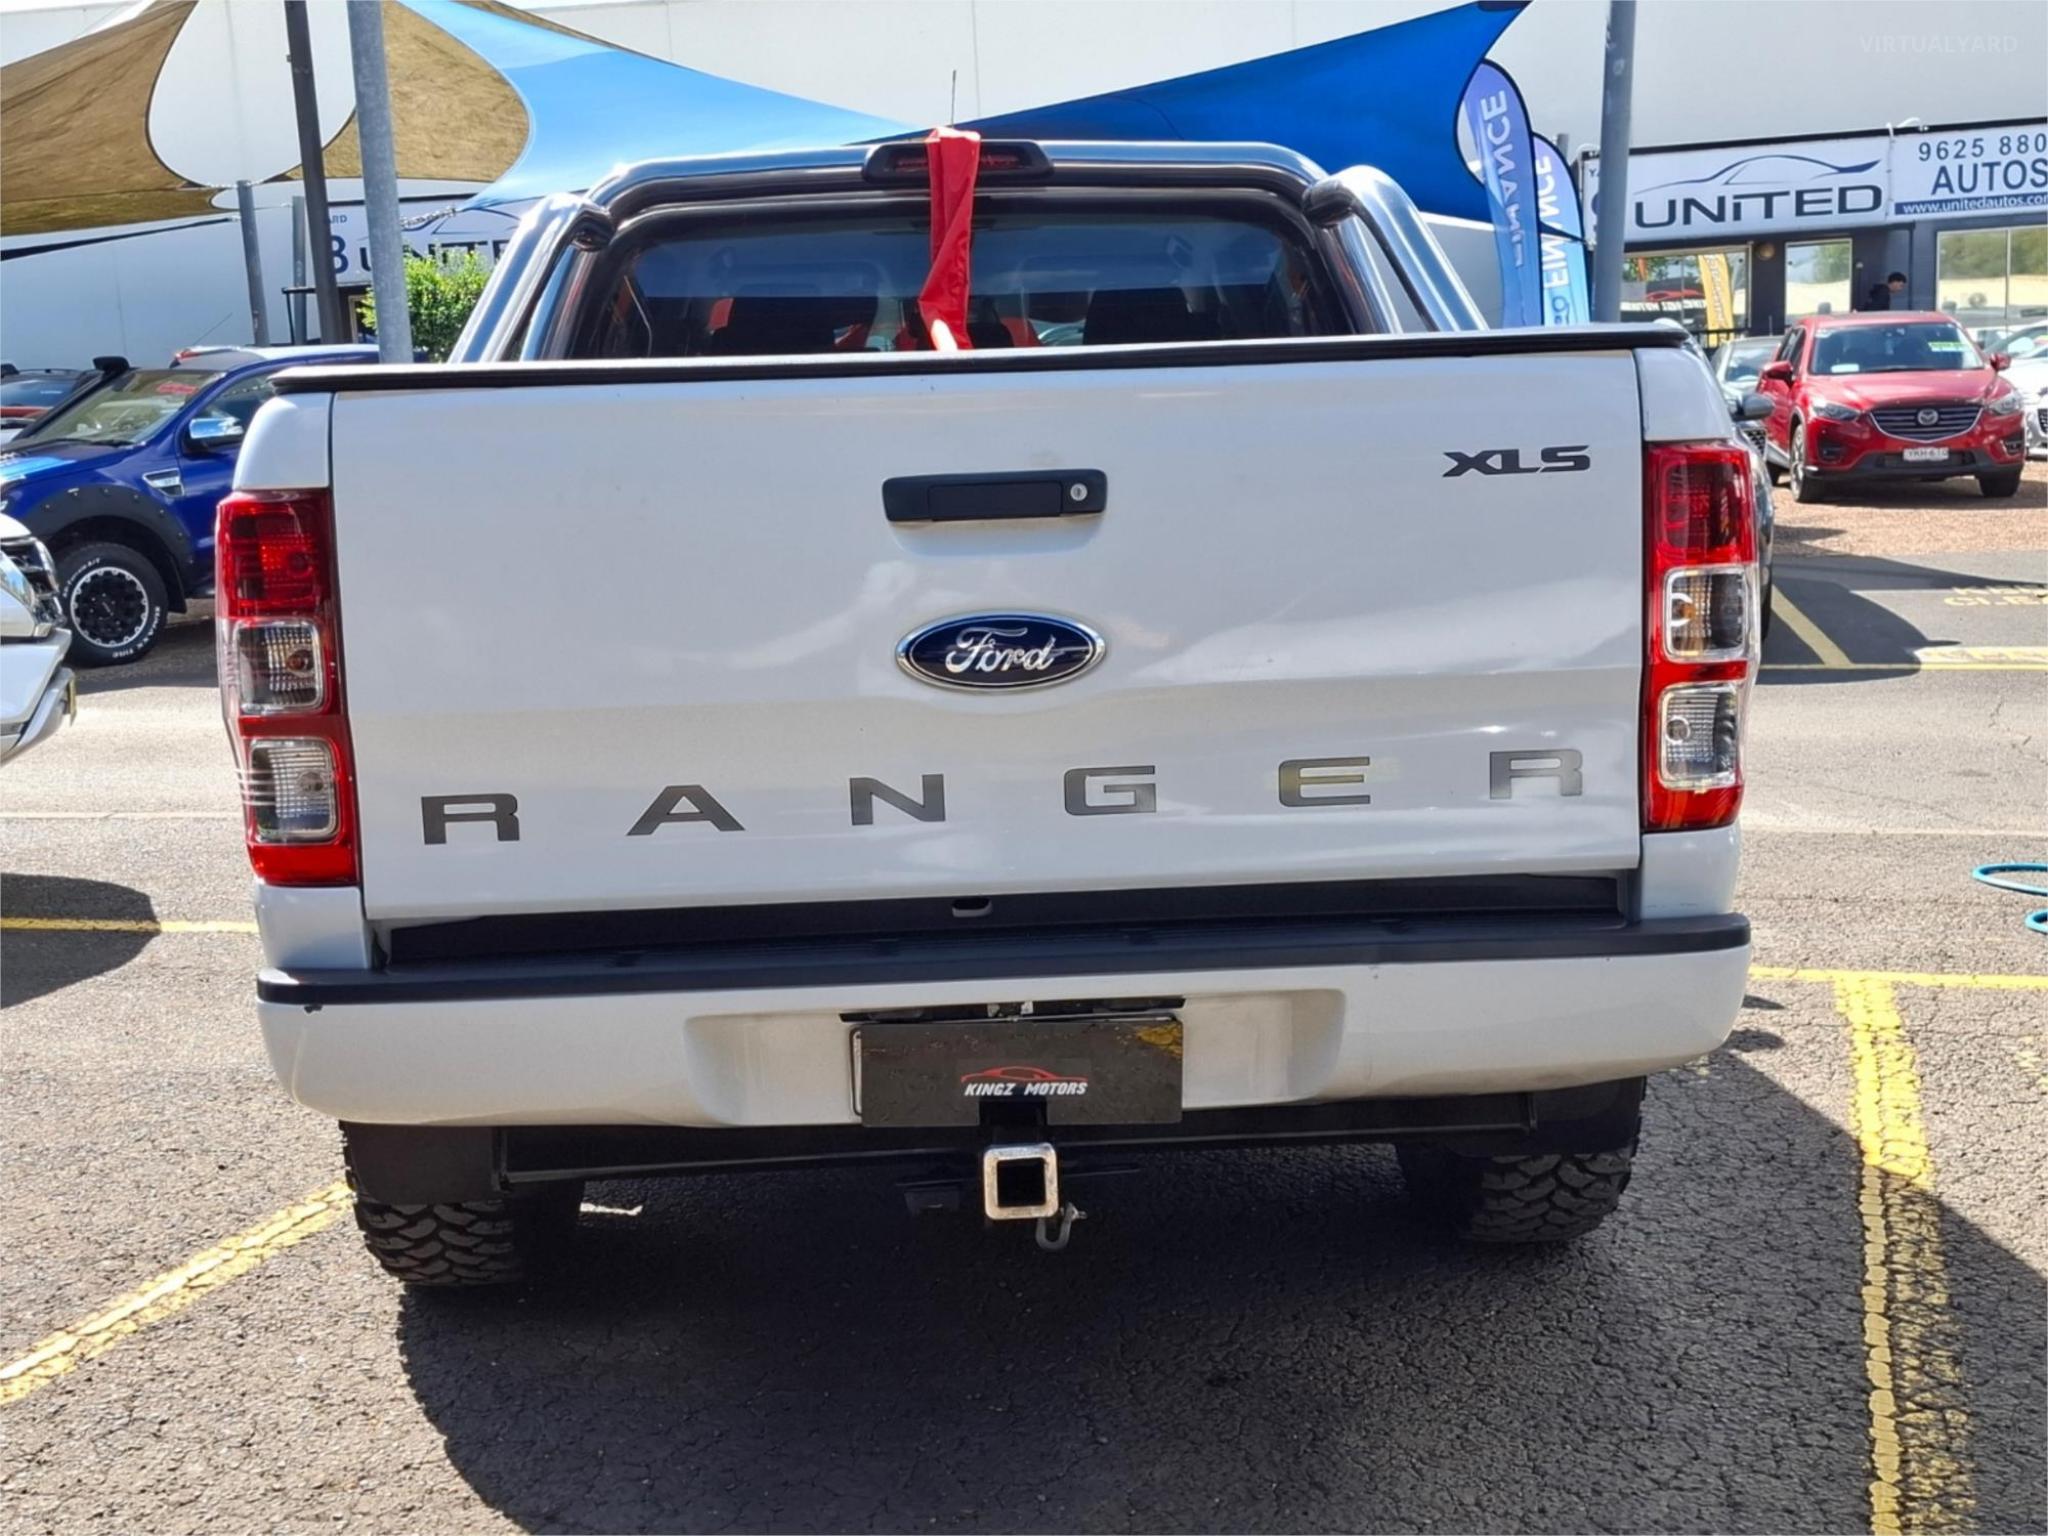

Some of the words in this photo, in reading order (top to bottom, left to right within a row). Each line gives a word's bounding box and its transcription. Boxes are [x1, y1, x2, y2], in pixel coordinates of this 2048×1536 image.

[1918, 136, 1984, 162] 9625
[1999, 132, 2047, 156] 880
[1931, 157, 2047, 196] AUTOS
[1635, 185, 1883, 228] UNITED
[1442, 445, 1591, 477] XLS
[945, 627, 1057, 673] Ford
[421, 749, 1583, 845] RANGER
[964, 1082, 1016, 1097] KINGZ
[1024, 1081, 1088, 1096] MOTORS
